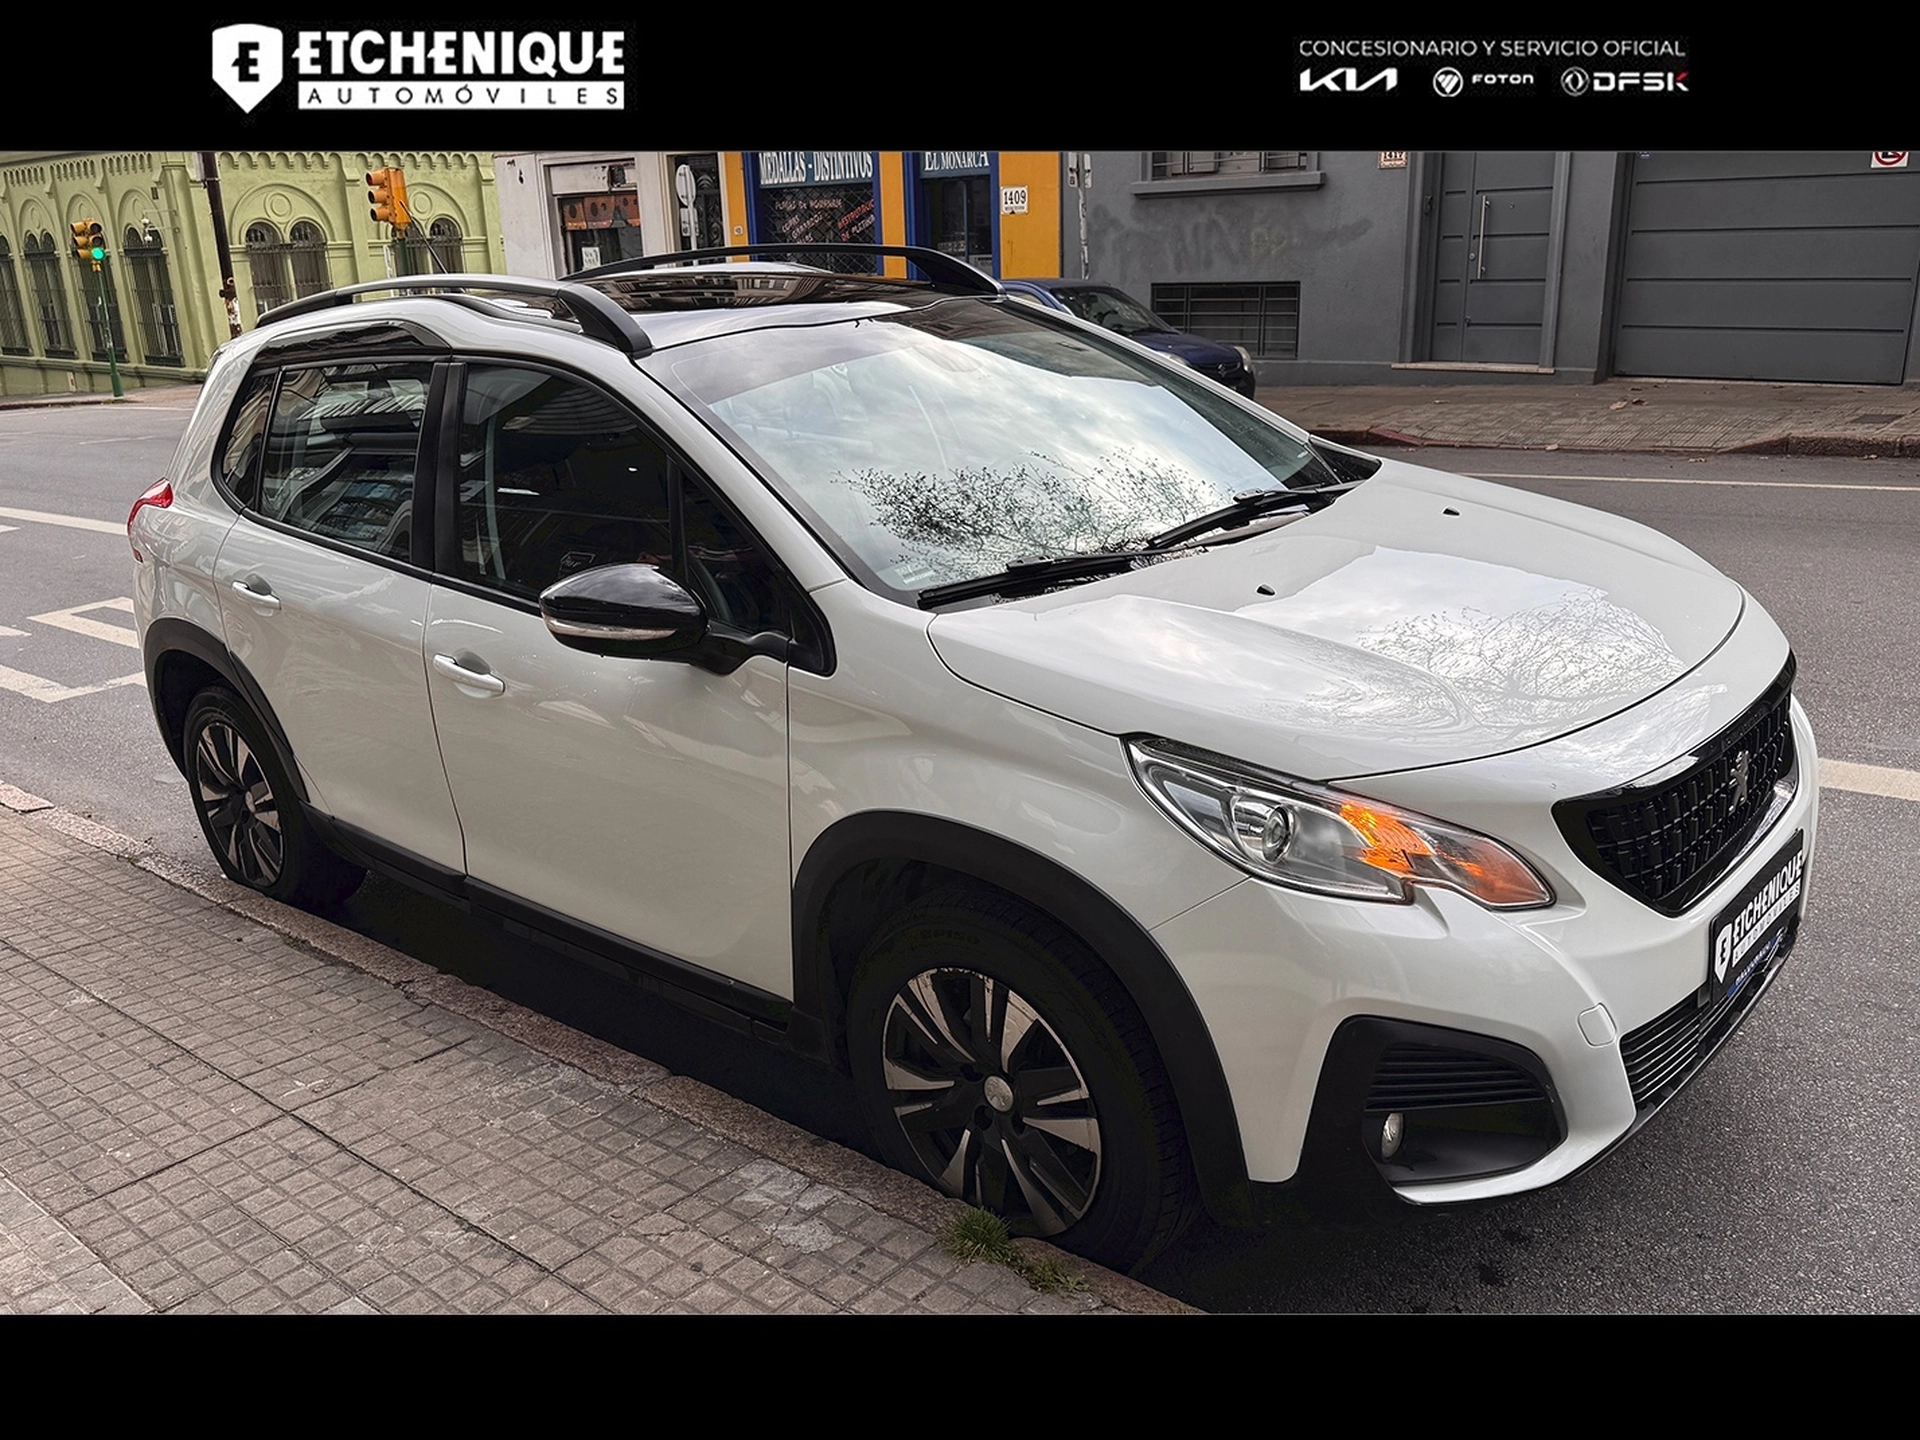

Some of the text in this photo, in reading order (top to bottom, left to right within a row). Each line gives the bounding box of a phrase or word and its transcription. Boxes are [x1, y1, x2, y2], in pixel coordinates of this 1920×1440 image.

[759, 152, 808, 185] MEDALLAS
[813, 152, 873, 181] DISTINTIVOS
[940, 152, 990, 170] MONARCA
[1003, 190, 1026, 206] 1409
[1732, 850, 1804, 947] ETCHENIQUE
